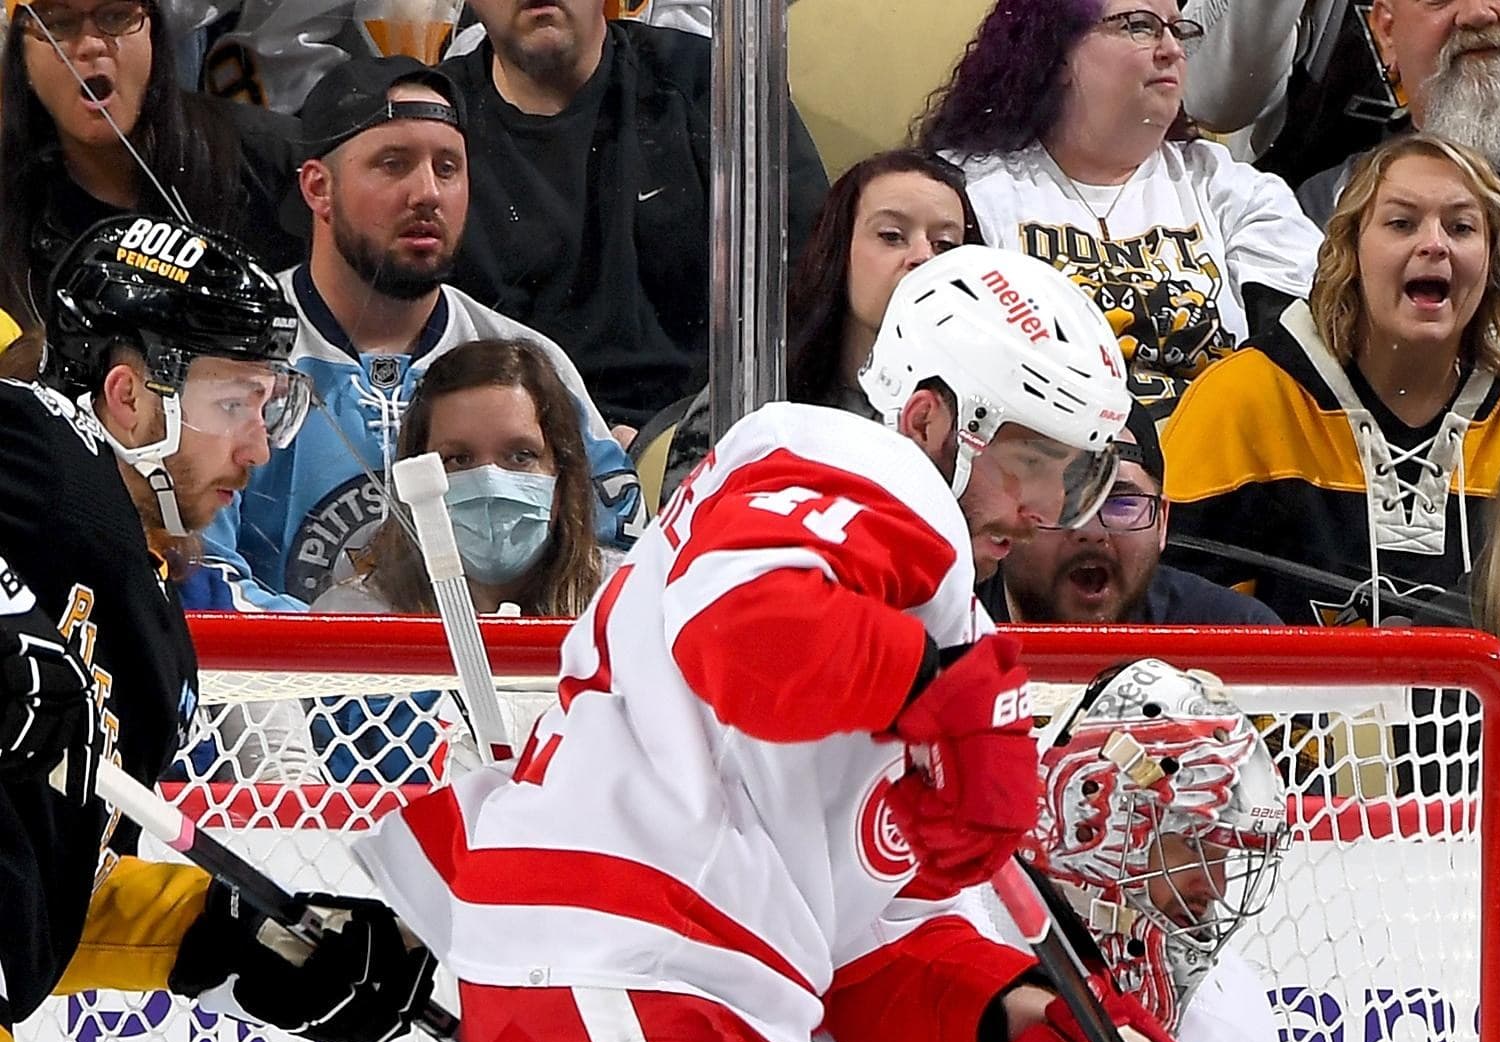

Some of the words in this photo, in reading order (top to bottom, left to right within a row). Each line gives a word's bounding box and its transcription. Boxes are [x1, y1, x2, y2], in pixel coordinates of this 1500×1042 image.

[116, 247, 190, 284] PENGUIN
[119, 217, 206, 269] BOLD
[1019, 223, 1202, 273] DON'T
[981, 270, 1050, 345] meijer
[298, 481, 384, 568] PITTS
[1250, 807, 1285, 819] BAUE
